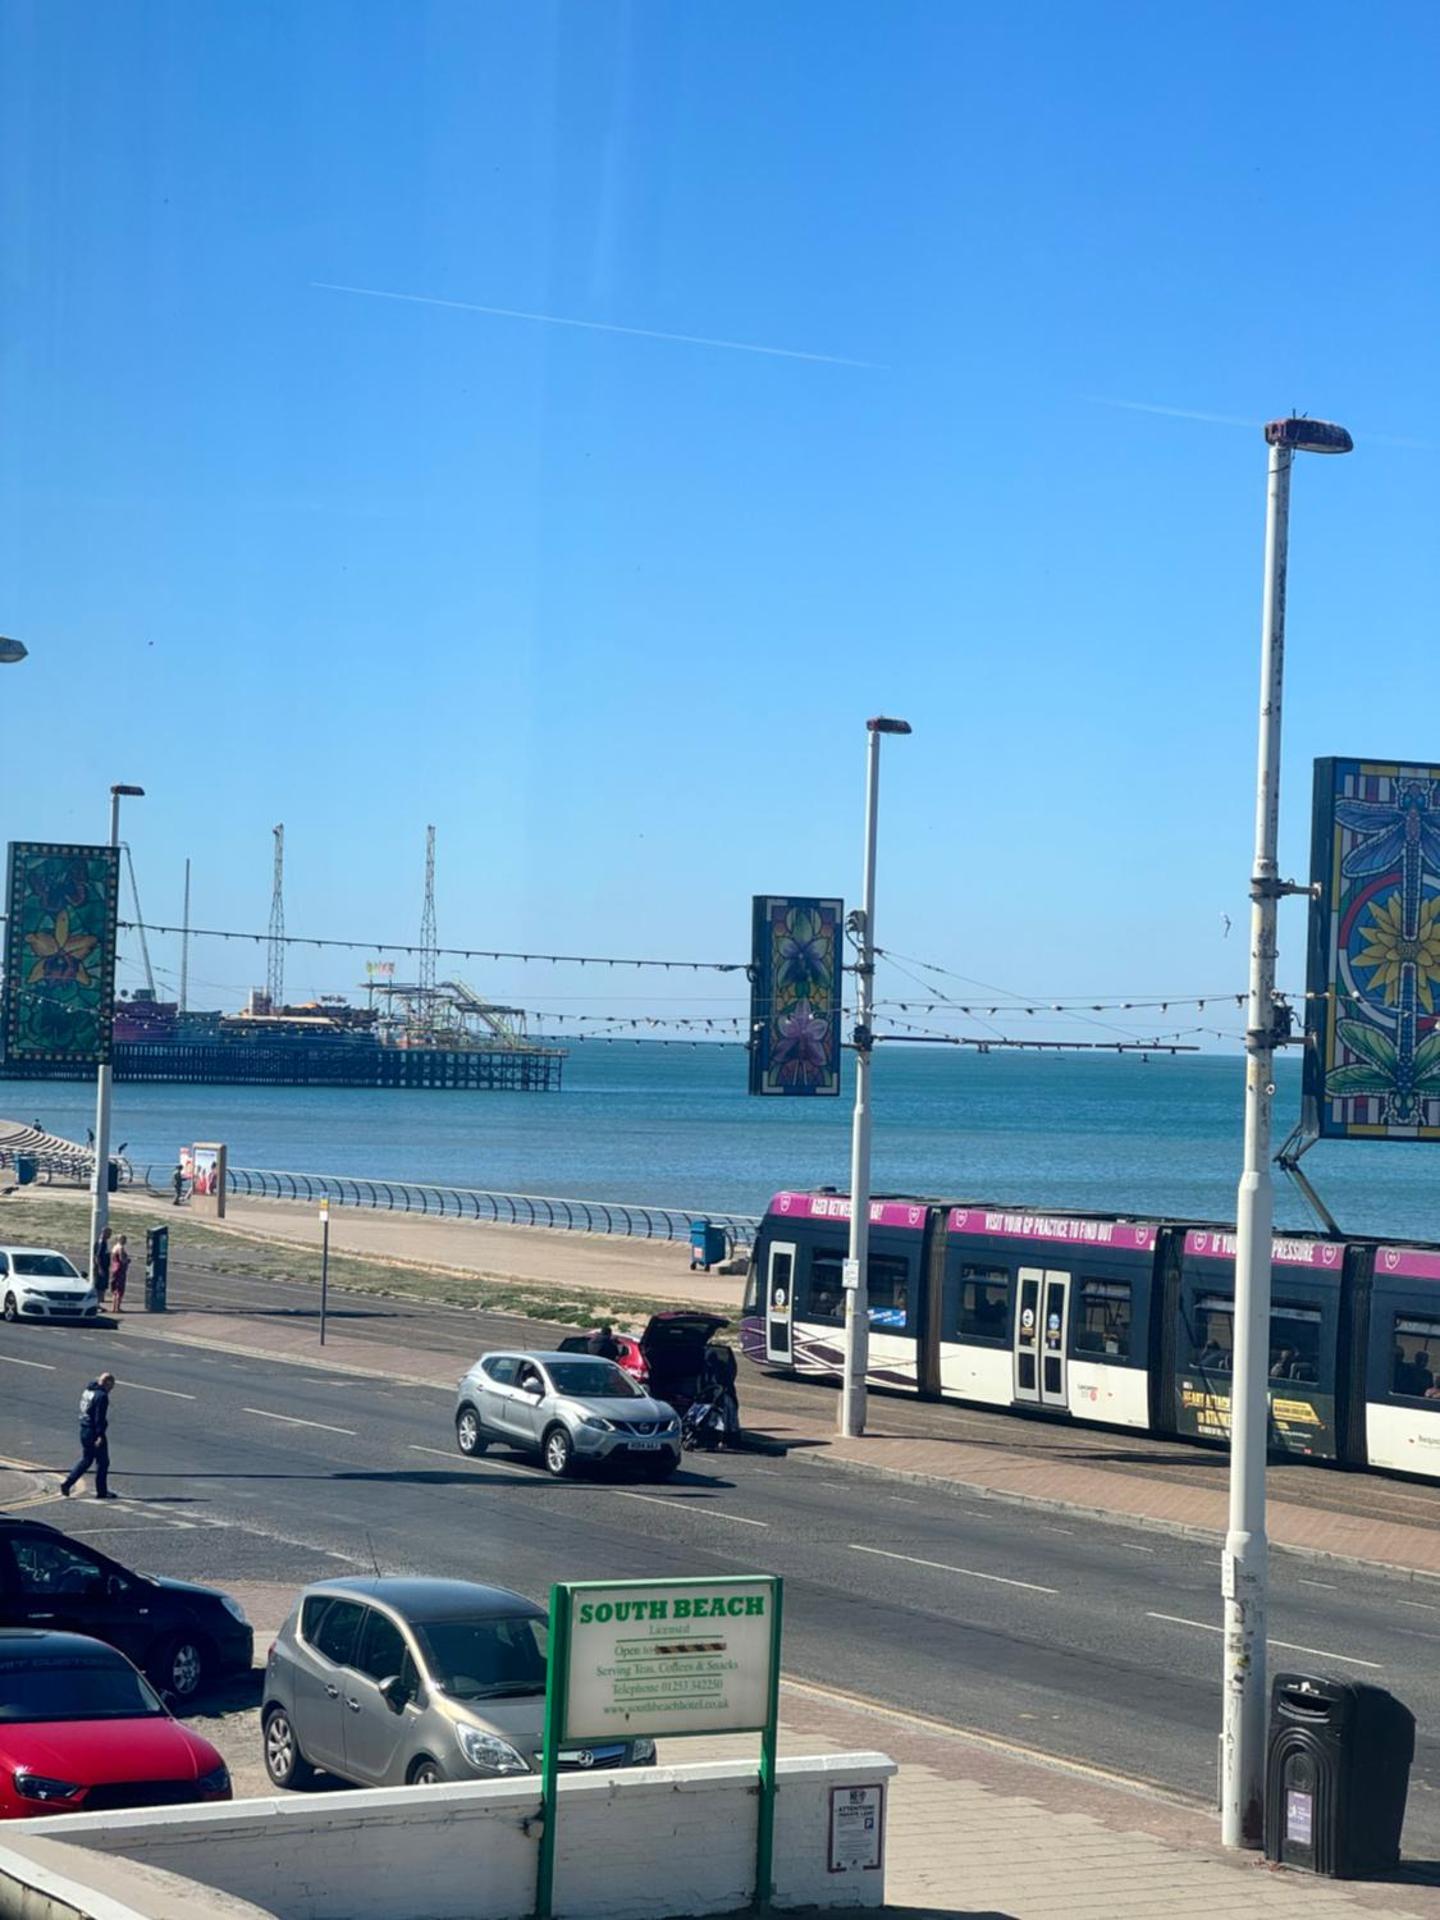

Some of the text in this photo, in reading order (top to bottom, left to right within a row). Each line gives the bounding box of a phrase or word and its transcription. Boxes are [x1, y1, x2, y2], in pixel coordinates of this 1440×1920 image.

[985, 1213, 1113, 1242] VISIT YOUR GP PRACTICE TO FIND OUT
[1271, 1239, 1315, 1262] PRESSURE
[580, 1597, 765, 1624] SOUTH BEACH
[614, 1645, 640, 1658] Open
[596, 1664, 632, 1678] Serving
[659, 1661, 693, 1673] Coffees
[695, 1661, 705, 1671] &
[707, 1659, 738, 1671] Snacks
[613, 1682, 659, 1696] Telephone
[603, 1700, 729, 1715] www.southbeachhotel.co.uk
